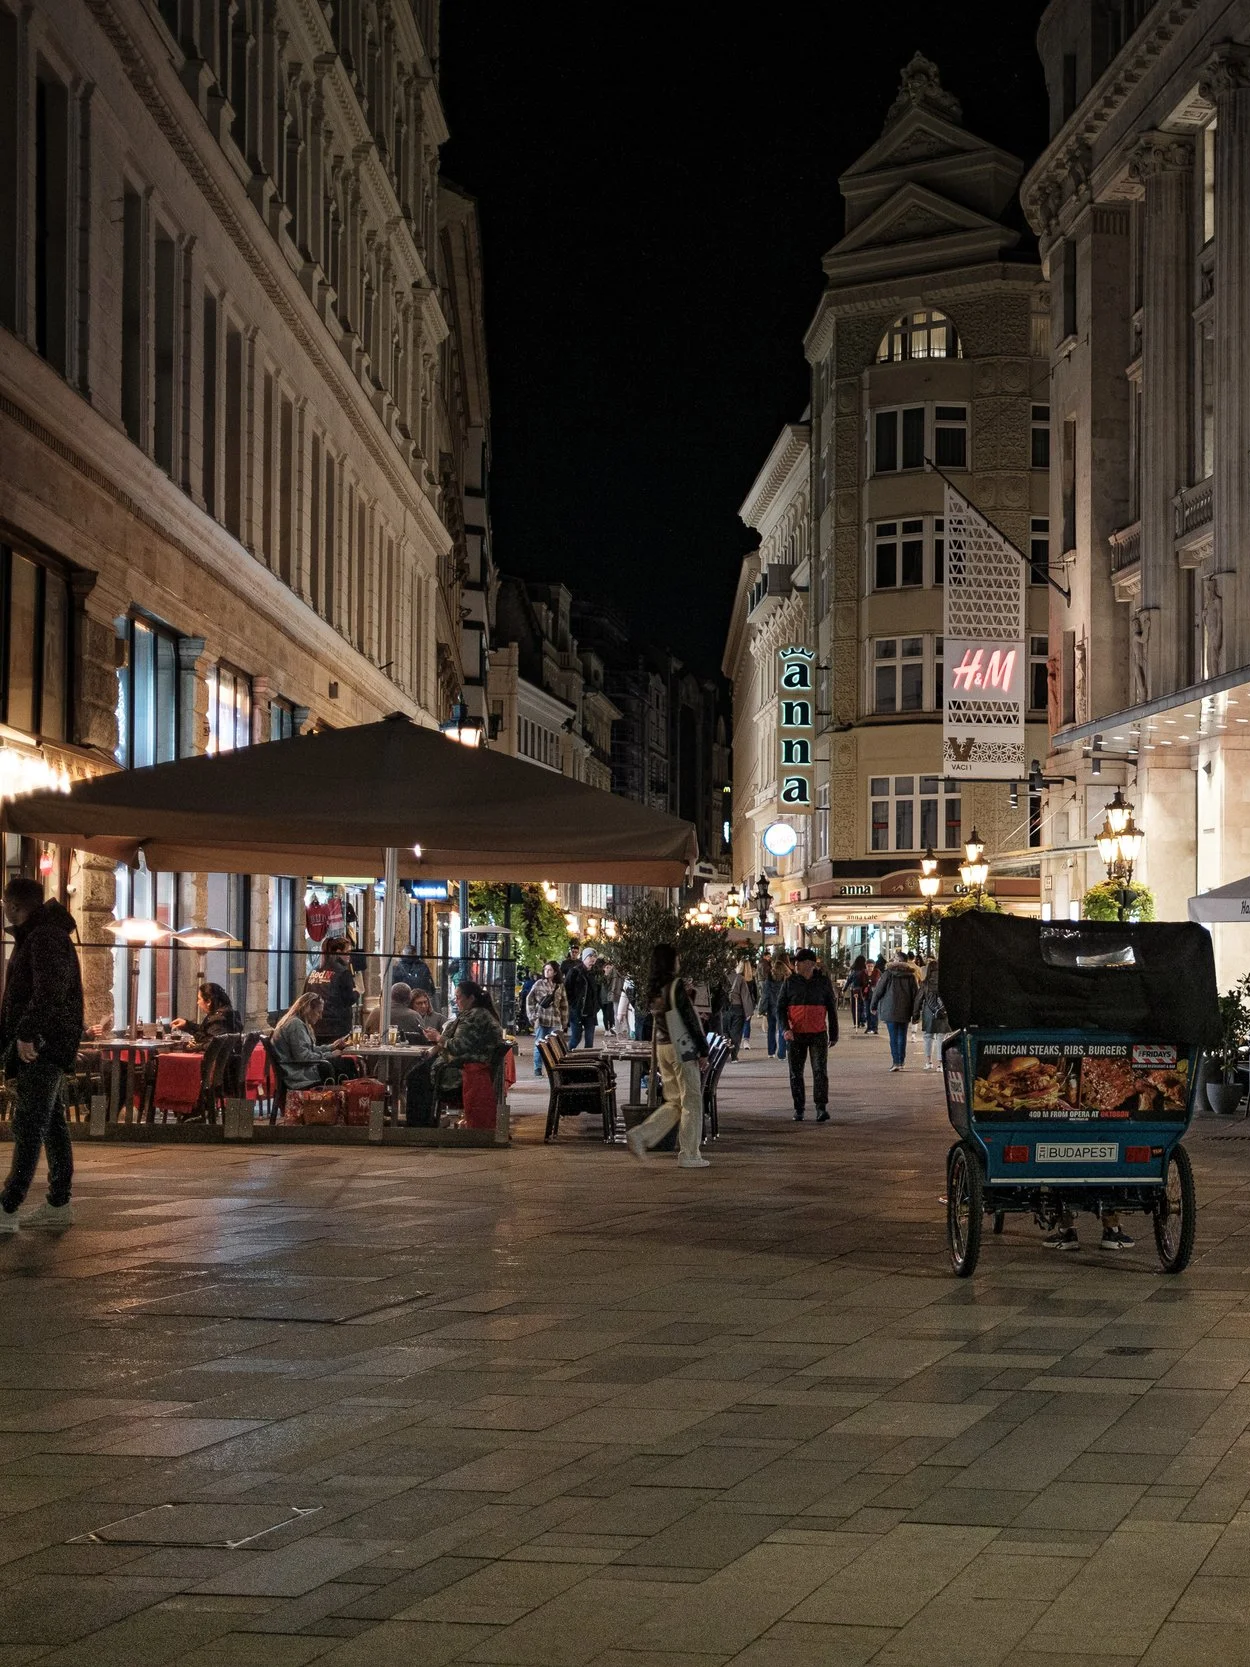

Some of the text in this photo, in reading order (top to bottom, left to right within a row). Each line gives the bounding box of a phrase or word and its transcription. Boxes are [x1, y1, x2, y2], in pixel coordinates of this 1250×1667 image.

[953, 648, 1016, 693] H&M
[782, 661, 812, 804] anna
[951, 762, 968, 771] VÁCI
[840, 884, 873, 896] anna
[984, 1045, 1027, 1055] AMERICAN
[1029, 1045, 1061, 1057] STEAKS,
[1064, 1045, 1086, 1057] RIBS,
[1088, 1045, 1127, 1056] BURGERS
[1142, 1050, 1171, 1058] FRIDAYS
[1050, 1110, 1068, 1118] FROM
[1069, 1110, 1090, 1118] OPERA
[1091, 1110, 1099, 1118] AT
[1049, 1147, 1115, 1159] BUDAPEST
